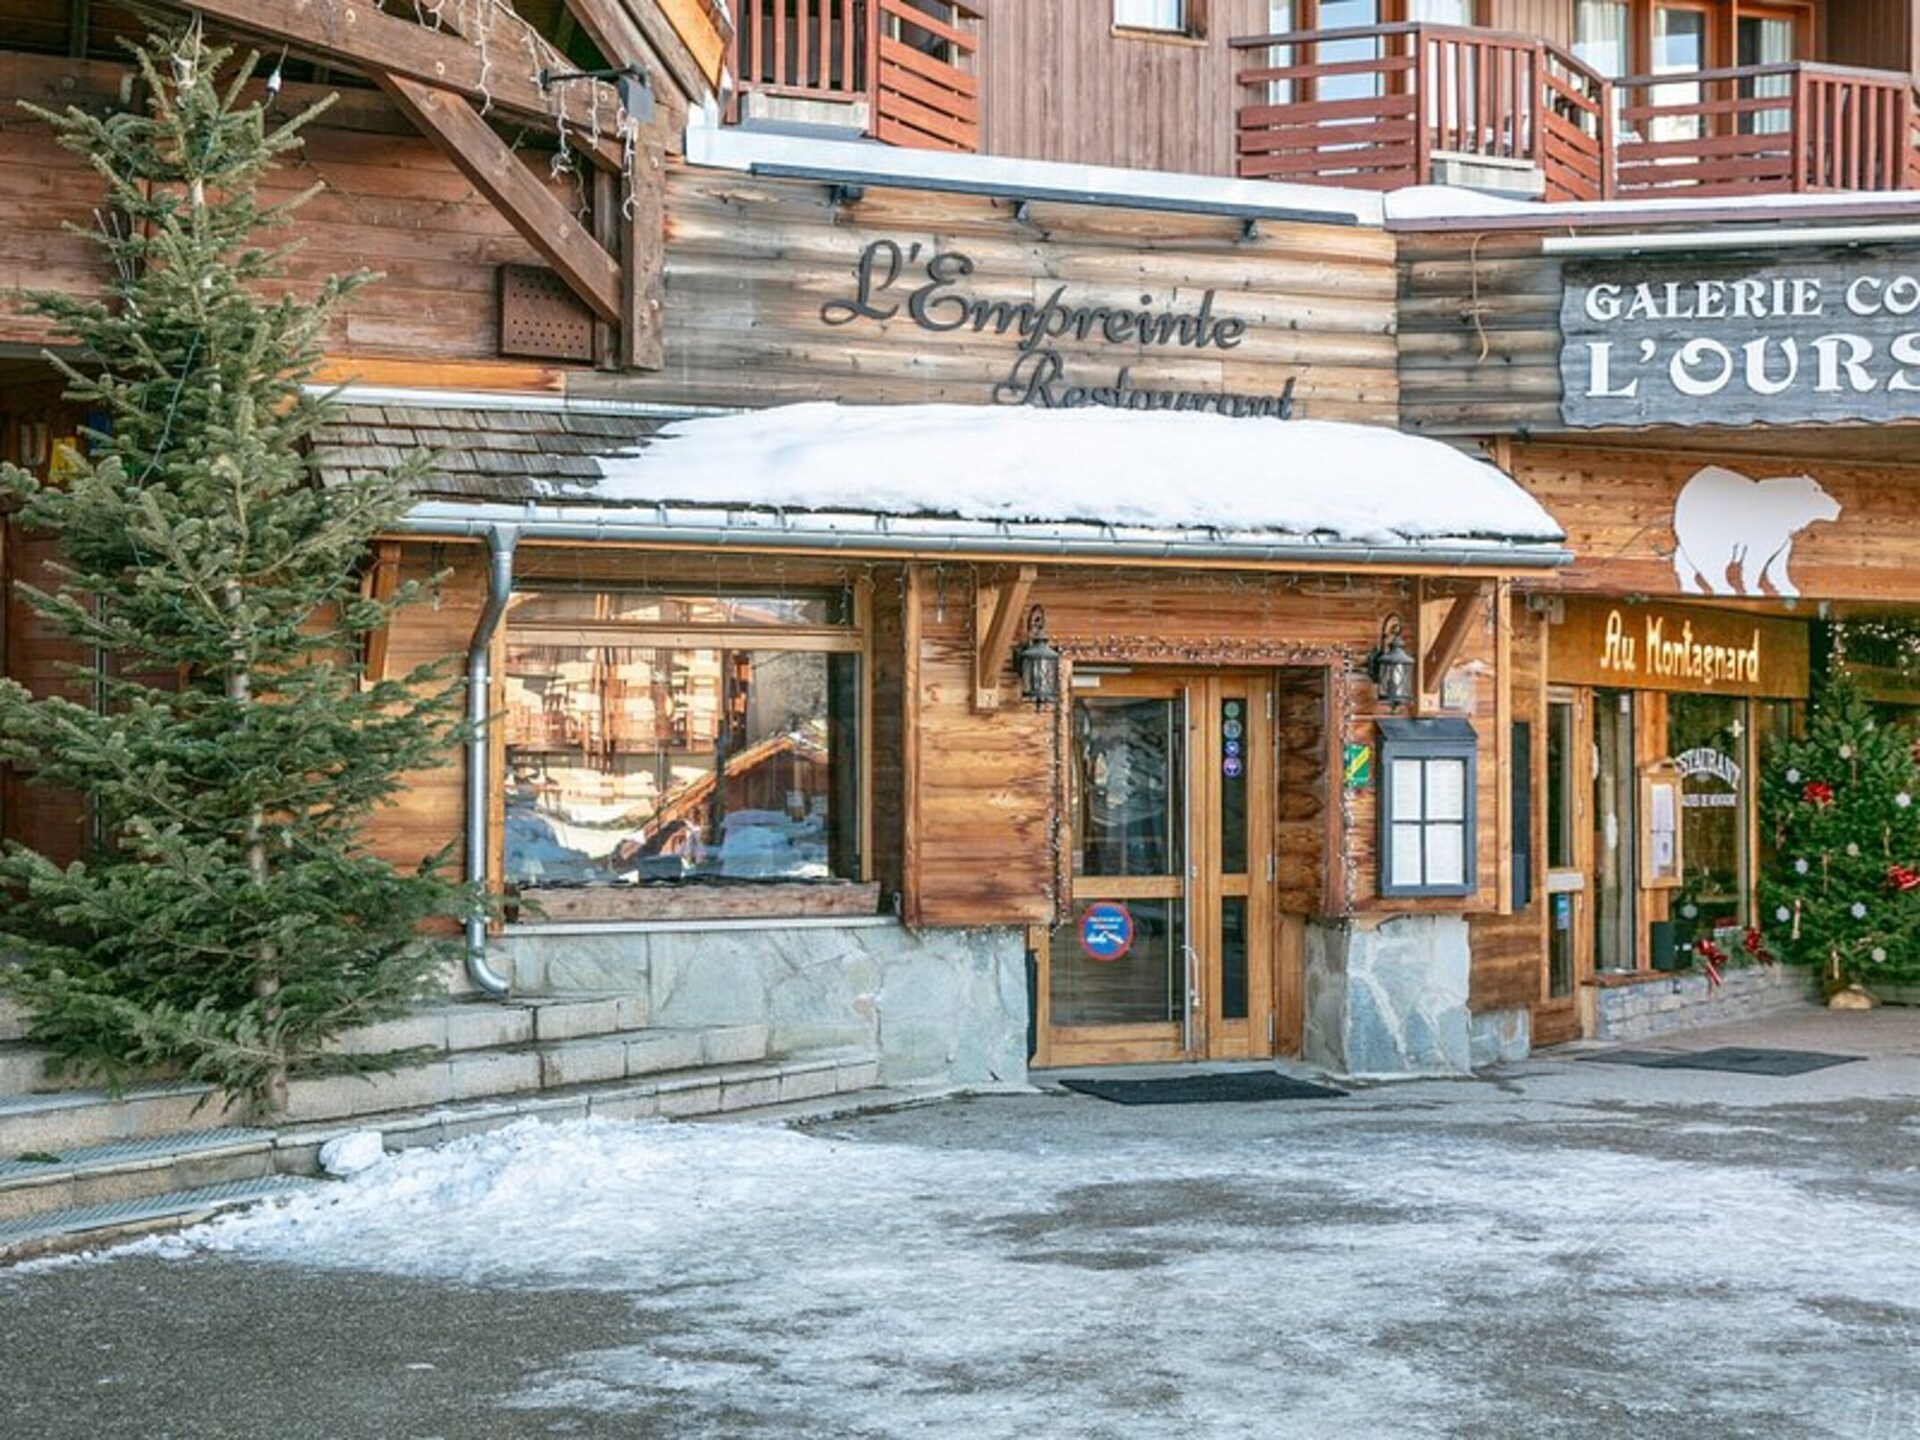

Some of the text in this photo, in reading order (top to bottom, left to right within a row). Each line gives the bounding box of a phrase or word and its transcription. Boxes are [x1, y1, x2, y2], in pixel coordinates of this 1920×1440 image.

[820, 239, 1247, 351] L'Empreinte
[1585, 277, 1822, 321] GALERIE
[993, 349, 1297, 421] Restaurant
[1585, 332, 1920, 397] L'OURS
[1601, 609, 1760, 685] Au Montagnard
